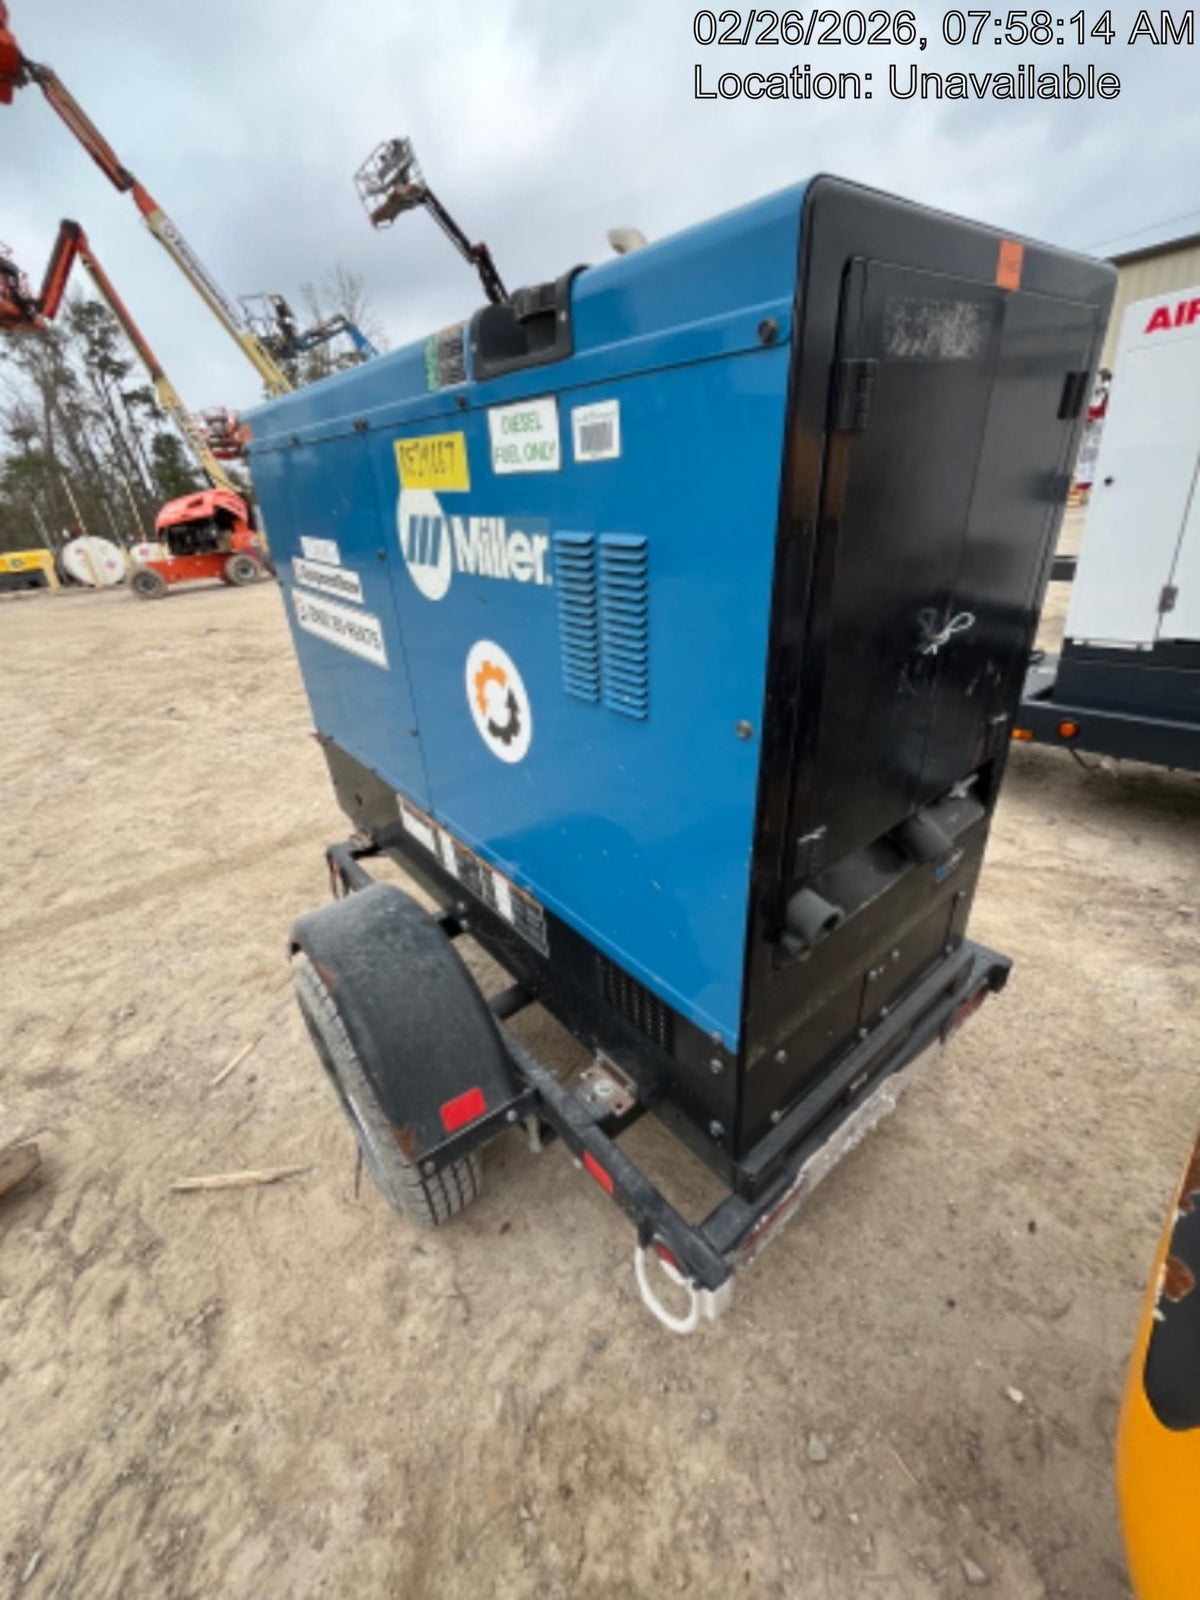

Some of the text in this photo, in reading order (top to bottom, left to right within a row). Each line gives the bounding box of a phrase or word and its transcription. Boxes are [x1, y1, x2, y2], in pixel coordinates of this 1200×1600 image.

[502, 411, 543, 435] DIESEL
[494, 440, 556, 465] FUEL ONLY
